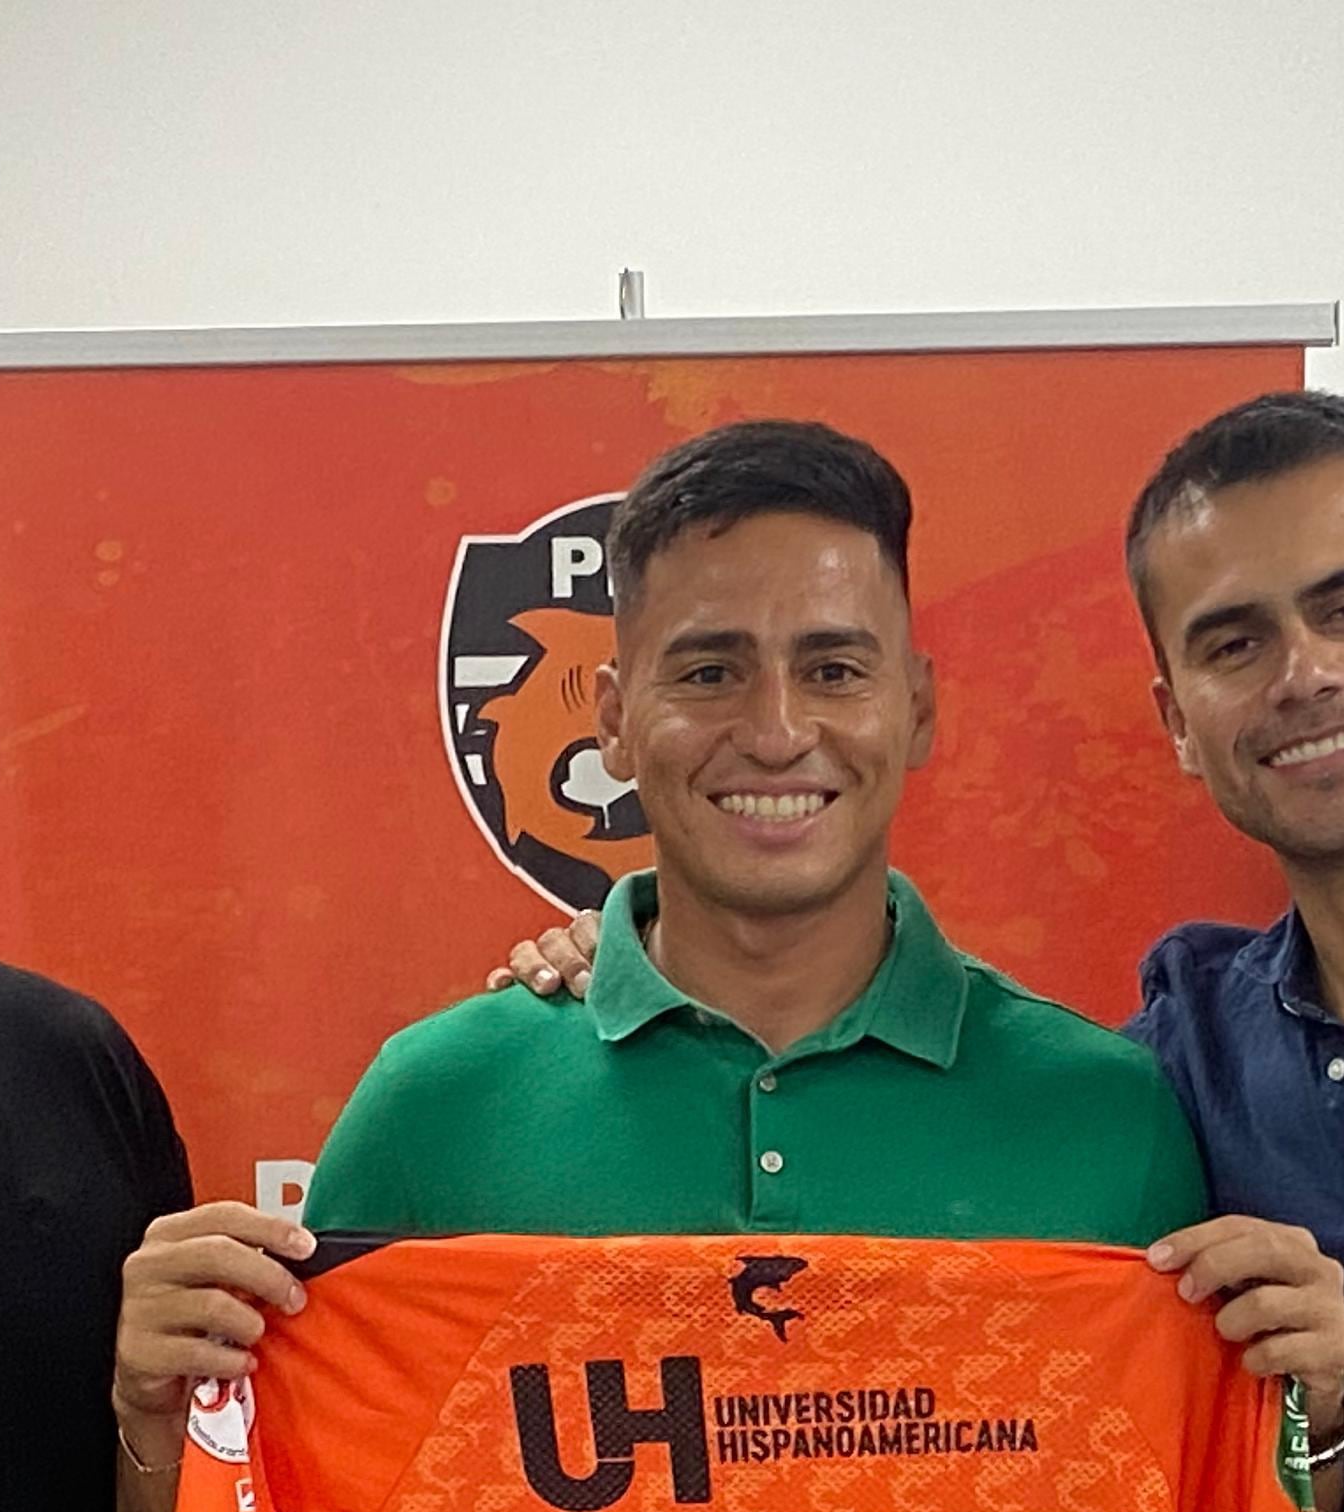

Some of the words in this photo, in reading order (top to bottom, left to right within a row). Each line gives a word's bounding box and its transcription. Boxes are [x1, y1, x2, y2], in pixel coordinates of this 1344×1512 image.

[551, 536, 614, 598] P
[714, 1387, 936, 1427] UNIVERSIDAD
[510, 1356, 713, 1512] UH
[716, 1419, 1038, 1464] HISPANOAMERICANA
